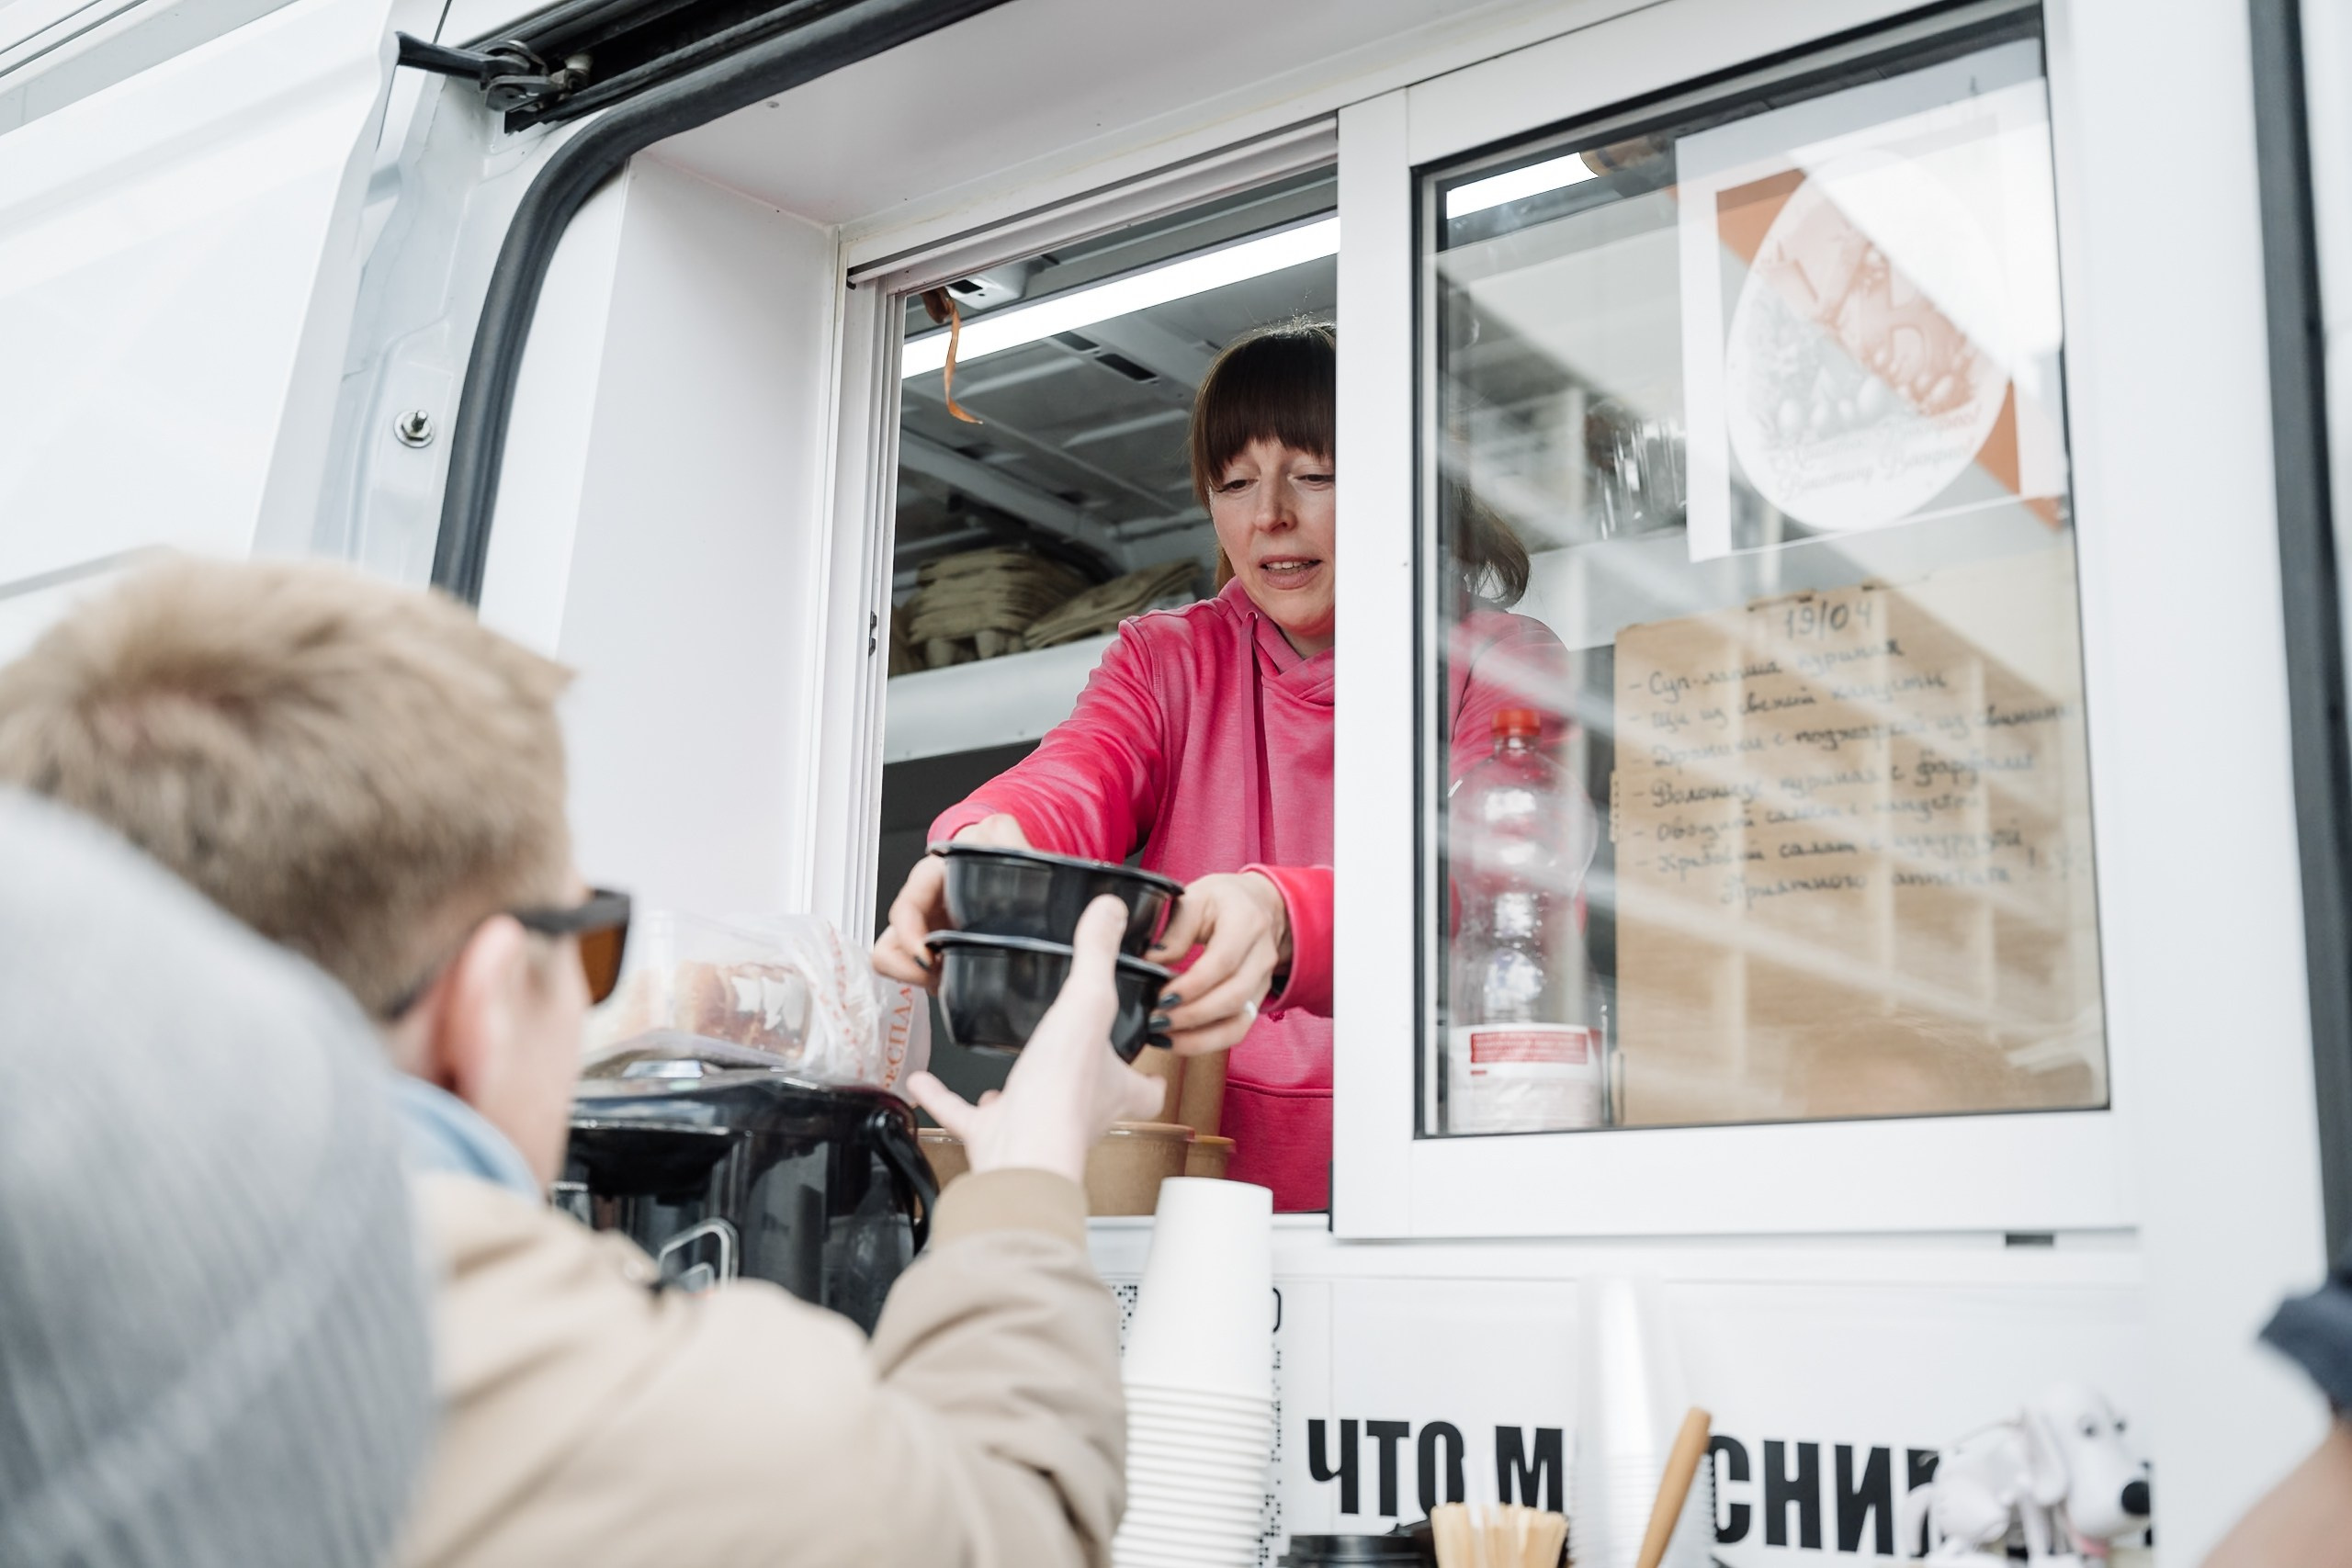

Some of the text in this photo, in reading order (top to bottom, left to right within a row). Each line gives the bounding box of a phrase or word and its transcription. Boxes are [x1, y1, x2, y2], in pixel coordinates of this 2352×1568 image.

[1785, 601, 1872, 640] 19/04
[1779, 840, 1859, 859] салат
[1307, 1418, 1465, 1518] ЧТО
